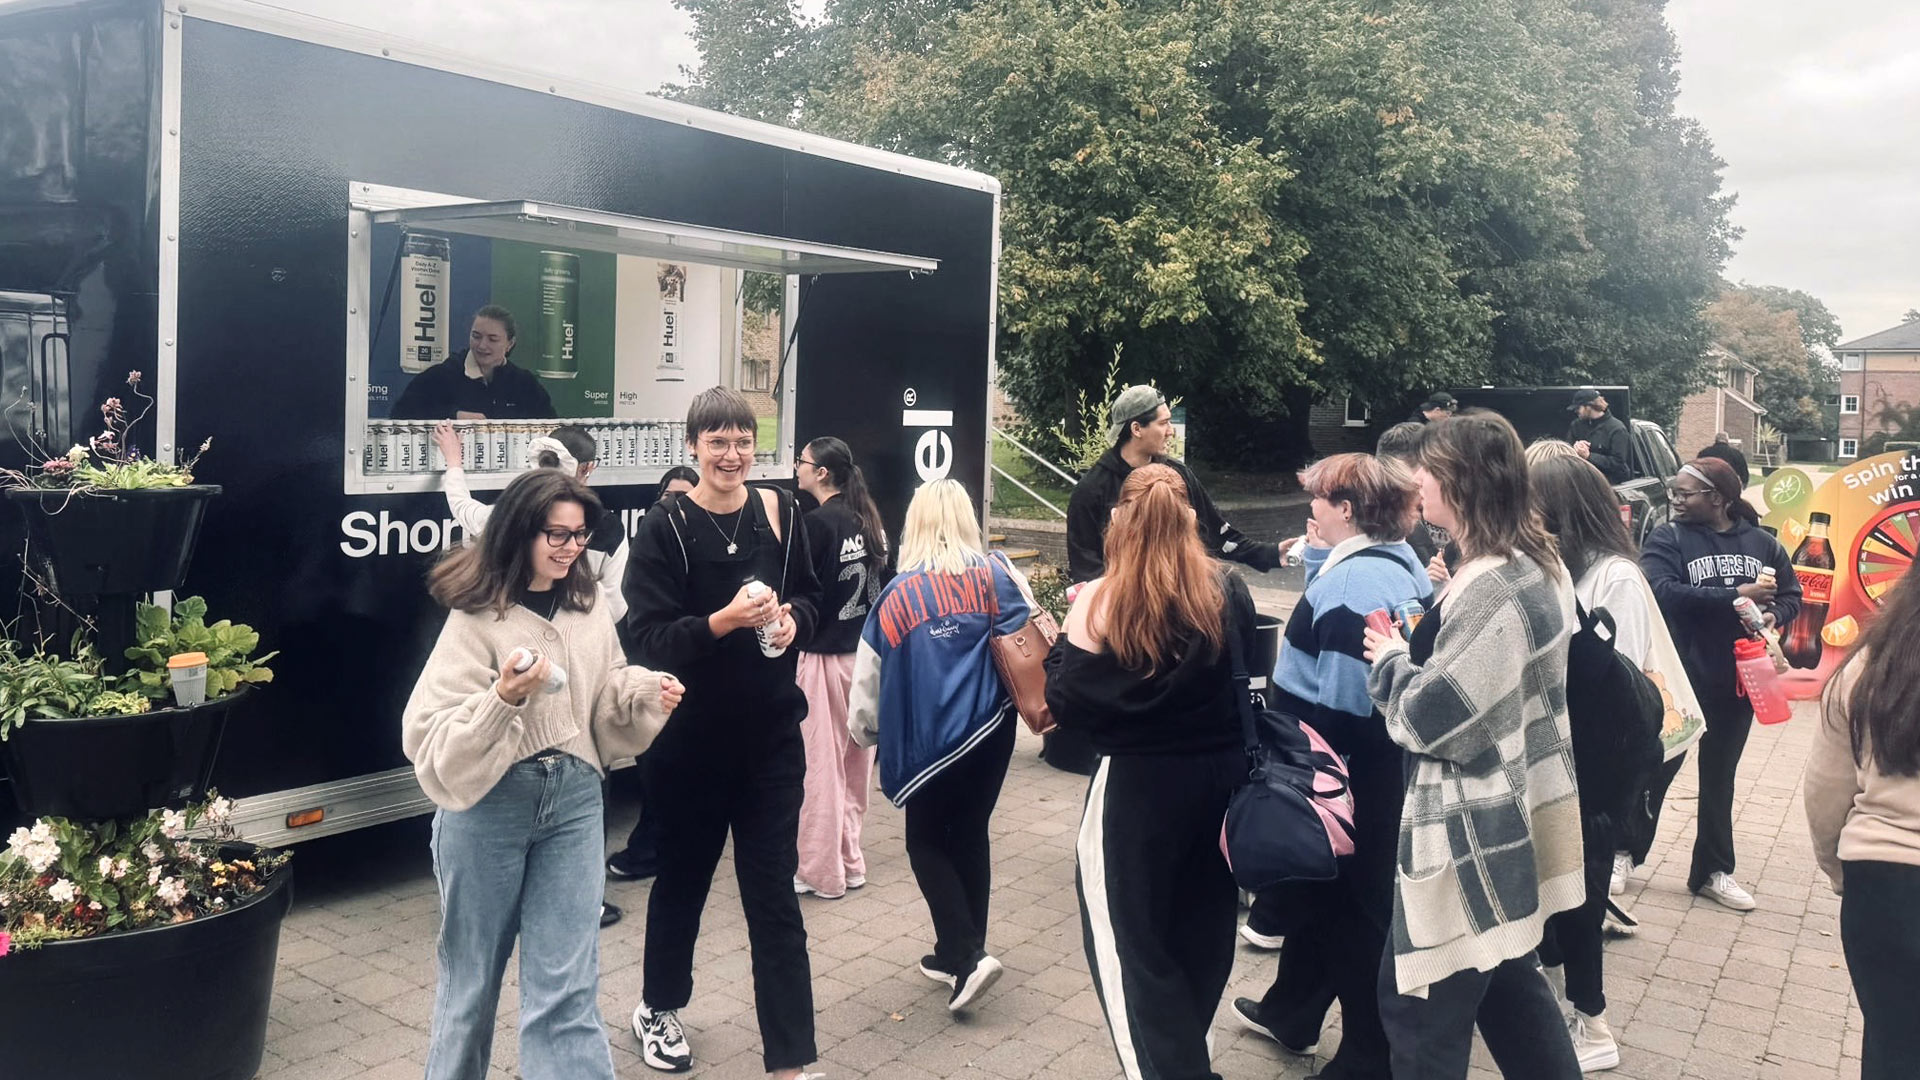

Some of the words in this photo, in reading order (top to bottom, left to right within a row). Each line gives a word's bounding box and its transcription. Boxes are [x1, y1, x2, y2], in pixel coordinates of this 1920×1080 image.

[414, 283, 436, 342] Huel
[562, 322, 574, 360] Huel
[663, 311, 674, 347] Huel
[584, 390, 609, 400] Super
[619, 391, 638, 401] High
[379, 443, 388, 468] Huel
[402, 443, 410, 467] Huel
[418, 442, 428, 466] Huel
[475, 442, 485, 464] Huel
[497, 441, 505, 463] Huel
[1843, 461, 1895, 490] Spin
[1894, 473, 1909, 482] for
[1868, 483, 1914, 505] win
[1687, 553, 1763, 589] UNIVERSITY
[878, 573, 931, 649] WALT
